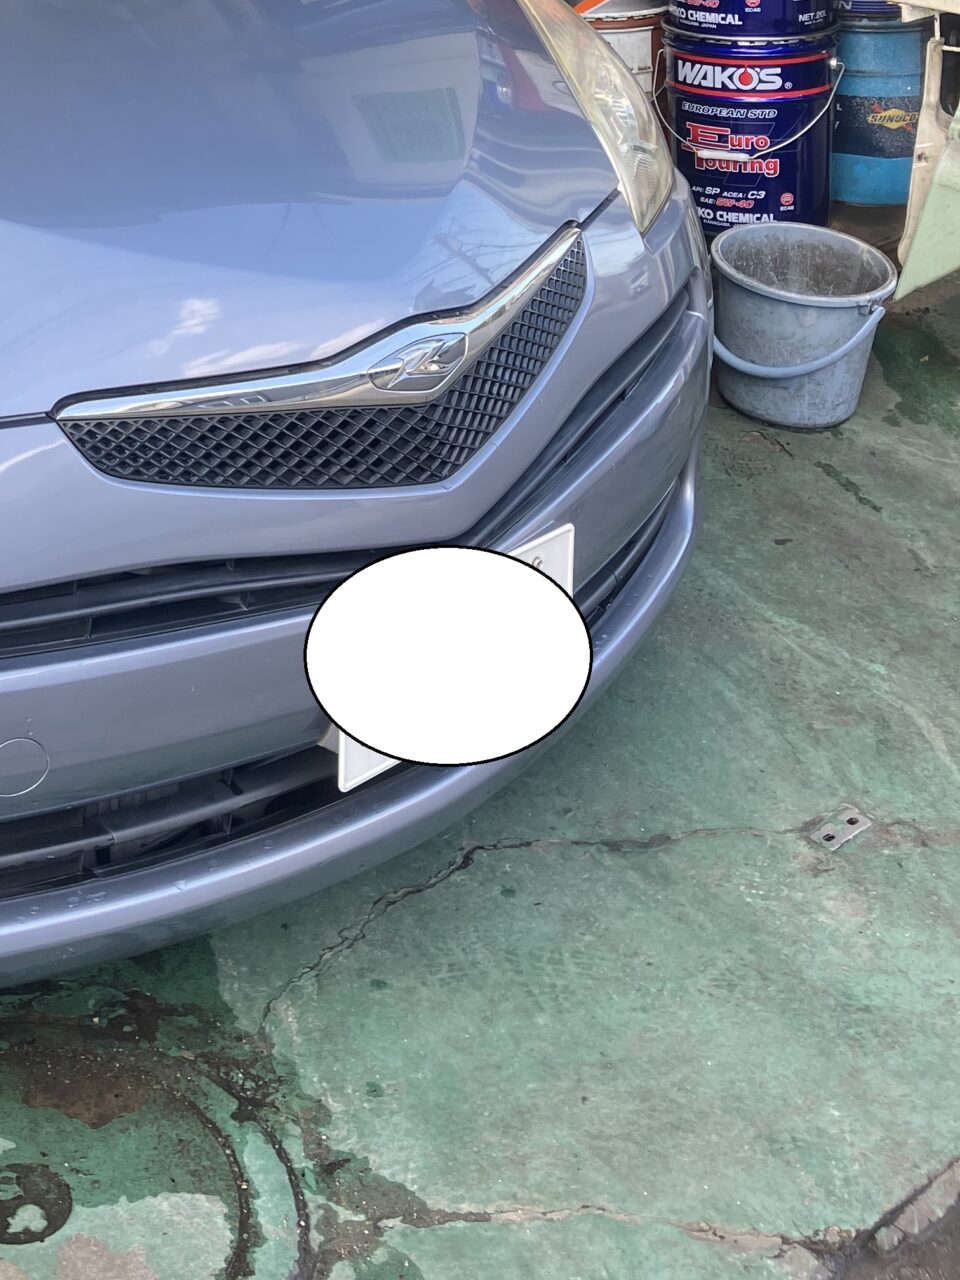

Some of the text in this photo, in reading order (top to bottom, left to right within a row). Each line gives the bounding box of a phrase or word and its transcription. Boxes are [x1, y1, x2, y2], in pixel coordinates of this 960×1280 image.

[687, 9, 743, 25] CHEMICAL
[677, 59, 783, 91] WAKO'S
[681, 101, 778, 119] EUROPEAN STD
[869, 111, 919, 123] SUNOCO
[681, 121, 771, 152] Euro
[704, 186, 721, 195] SP
[747, 190, 767, 199] C3
[715, 210, 778, 223] CHEMICAL
